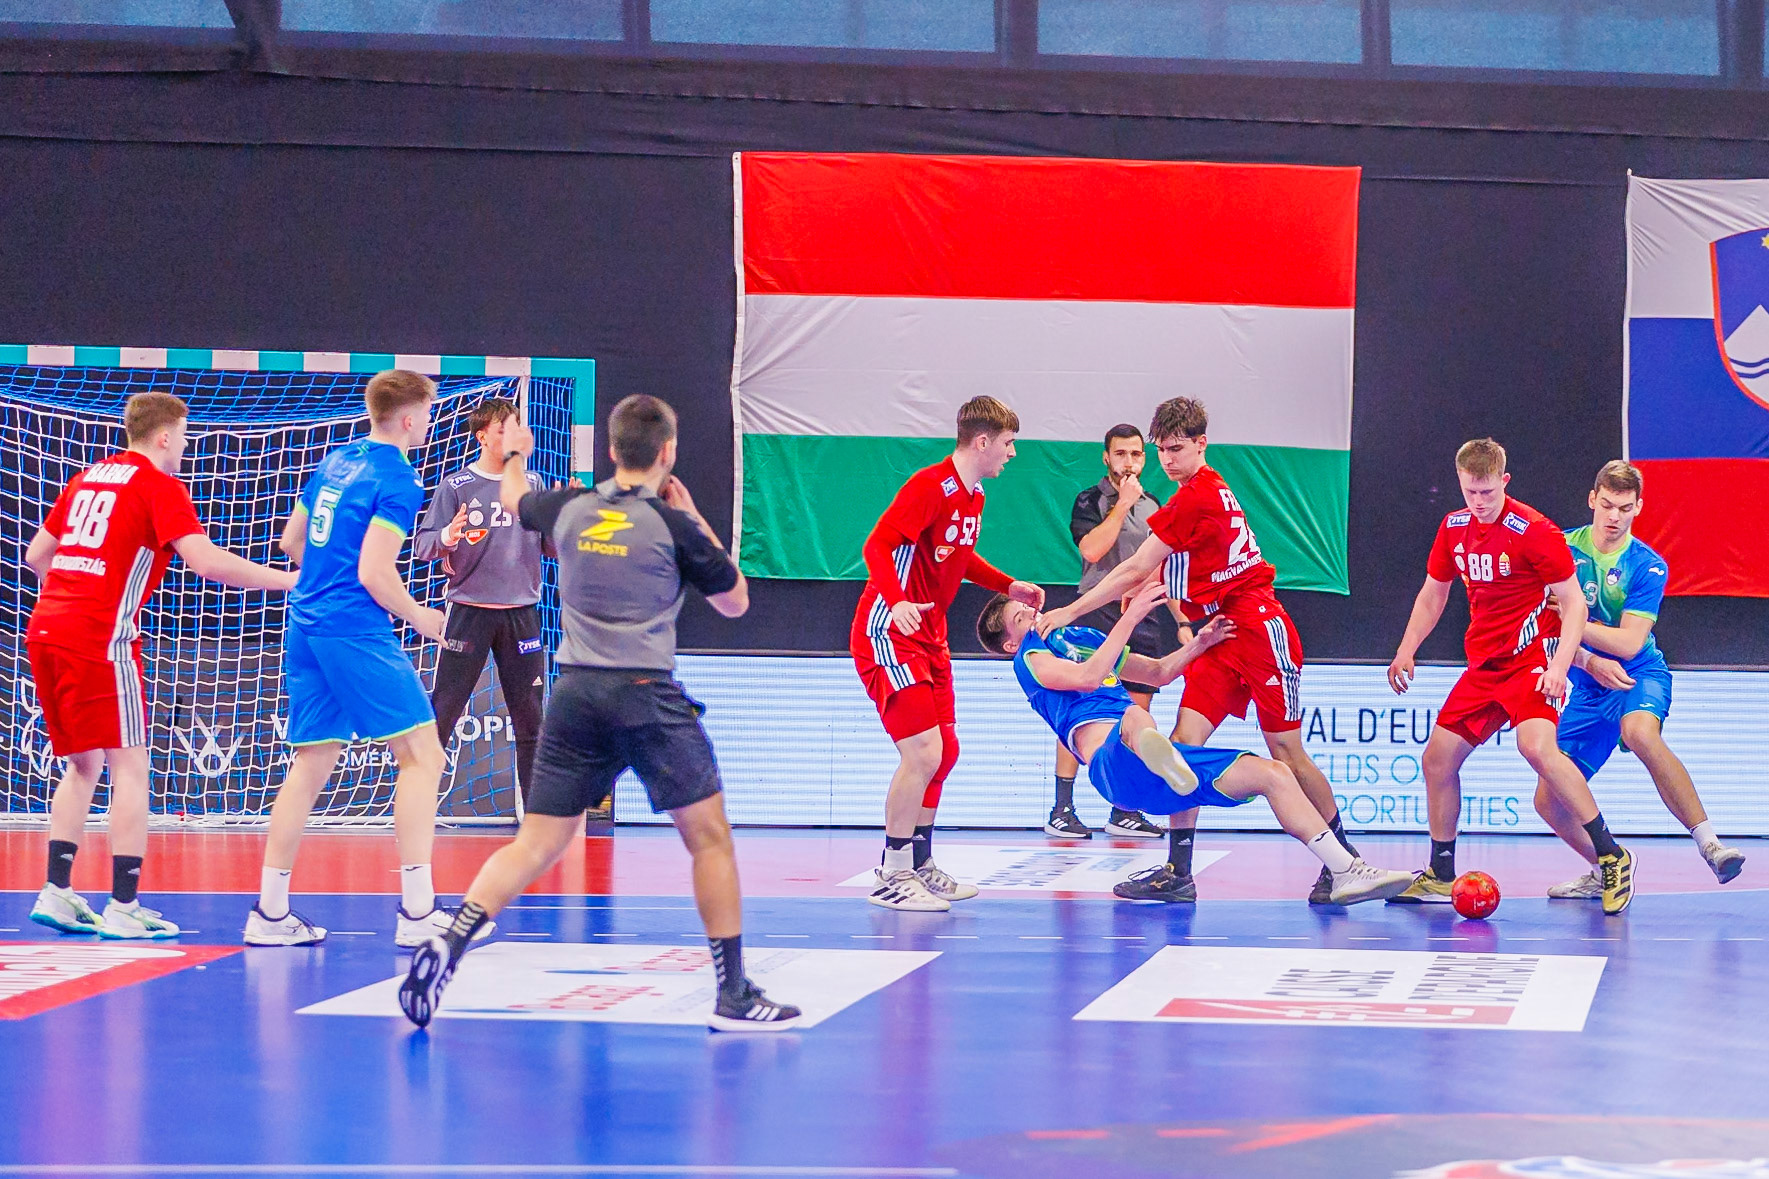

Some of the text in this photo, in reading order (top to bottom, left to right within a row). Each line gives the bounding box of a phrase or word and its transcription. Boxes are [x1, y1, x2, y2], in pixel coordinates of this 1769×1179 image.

[60, 490, 117, 548] 98
[309, 486, 343, 548] 5
[959, 516, 977, 546] 52
[1467, 553, 1494, 582] 88
